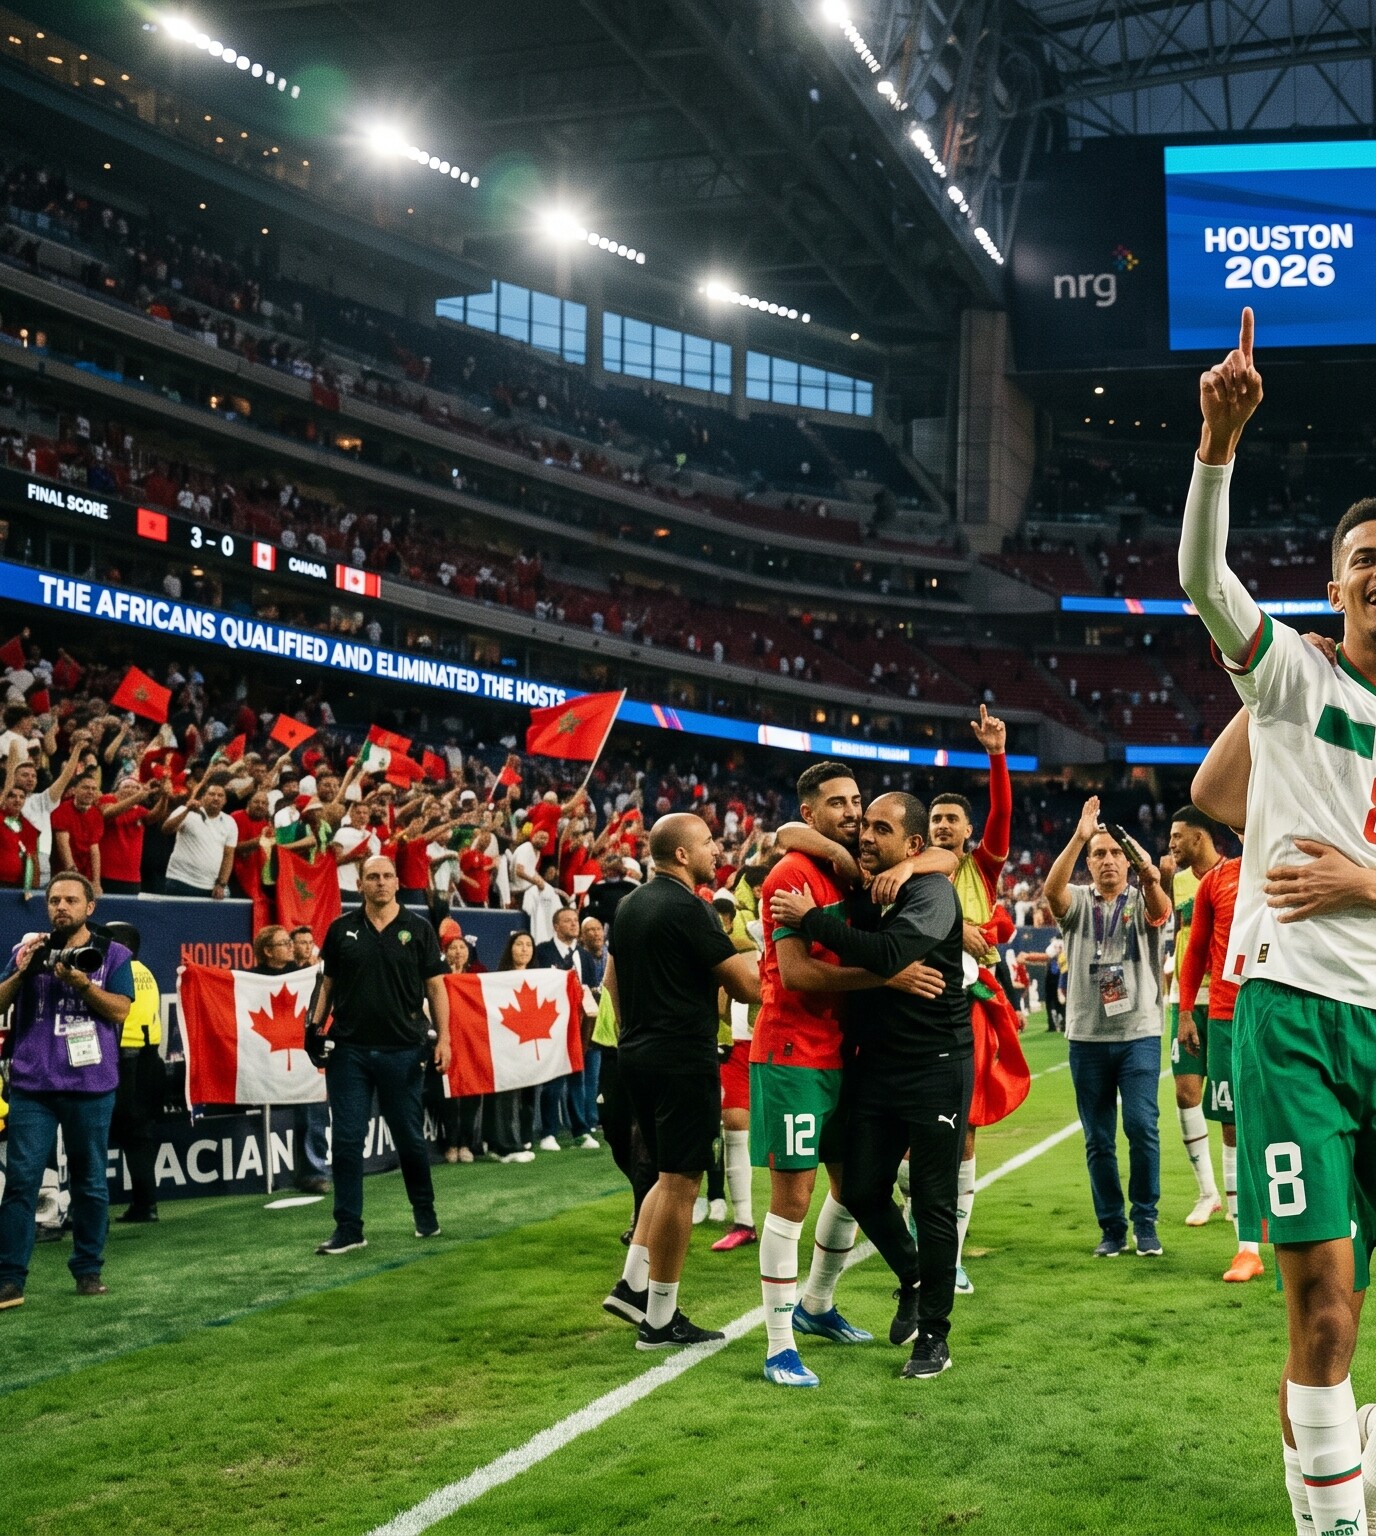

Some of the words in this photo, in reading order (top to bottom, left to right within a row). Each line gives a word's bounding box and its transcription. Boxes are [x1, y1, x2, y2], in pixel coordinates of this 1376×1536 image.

[1204, 222, 1354, 253] HOUSTON
[1224, 253, 1336, 289] 2026
[1053, 272, 1117, 307] nrg
[27, 483, 65, 509] FINAL
[66, 494, 109, 520] SCORE
[190, 526, 203, 549] 3
[221, 534, 235, 557] 0
[38, 574, 92, 613] THE
[95, 589, 216, 640] AFRICANS
[220, 617, 328, 663] QUALIFIED
[331, 642, 373, 673] AND
[376, 651, 480, 694] ELIMINATED
[482, 673, 514, 701] THE
[516, 681, 567, 708] HOSTS
[181, 942, 258, 971] HOUSTO
[1211, 1080, 1234, 1112] 14
[783, 1113, 816, 1156] 12
[1264, 1141, 1307, 1218] 8
